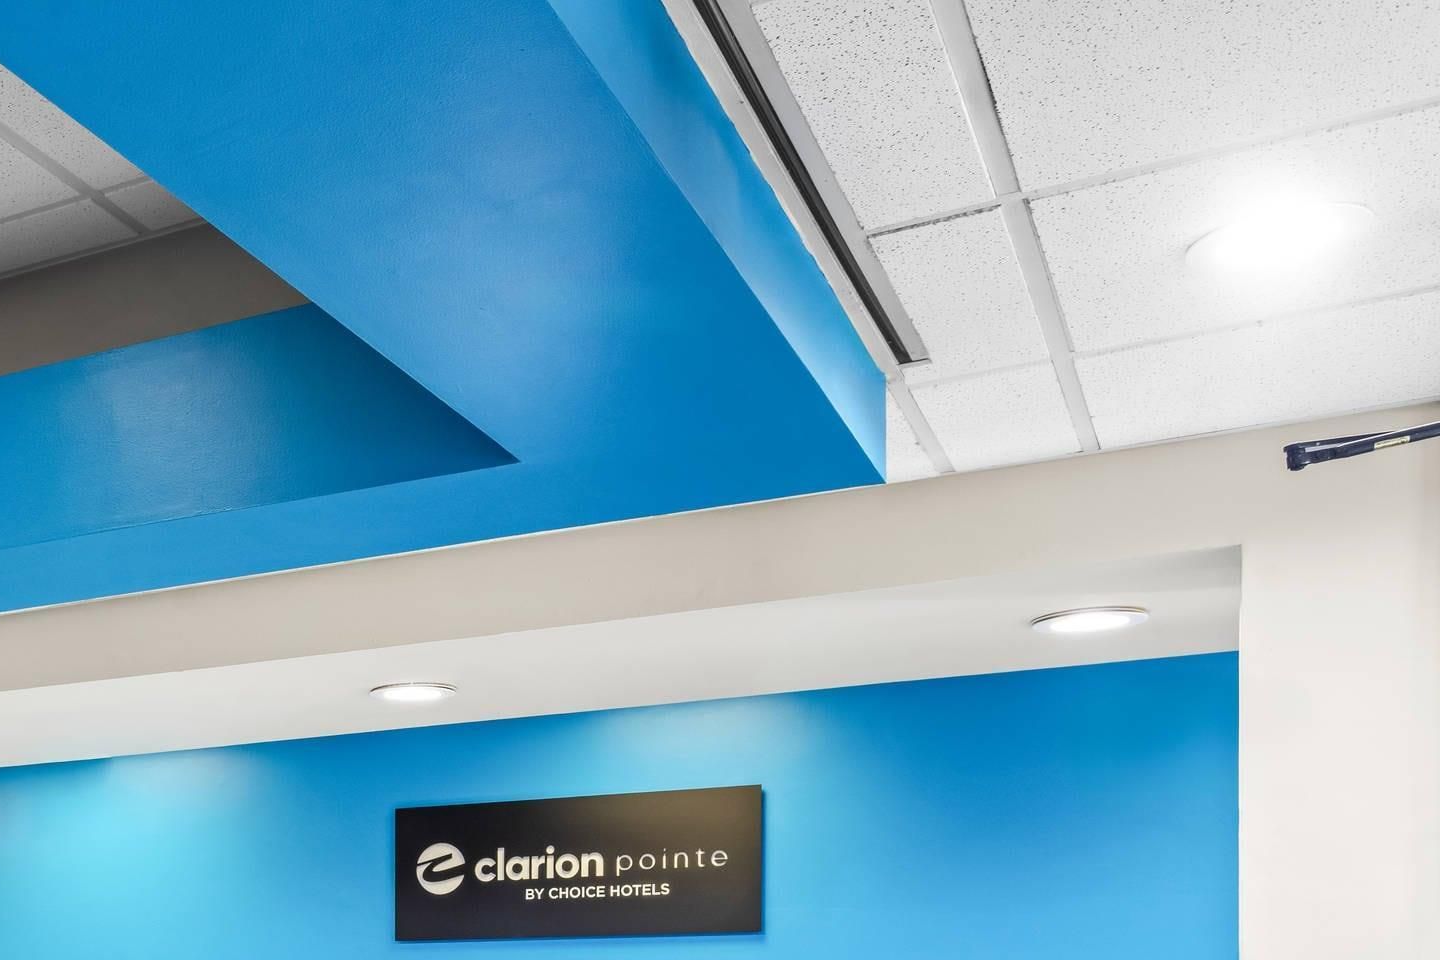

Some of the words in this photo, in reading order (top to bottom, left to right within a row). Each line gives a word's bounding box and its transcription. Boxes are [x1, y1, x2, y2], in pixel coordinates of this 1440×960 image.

[474, 845, 604, 882] clarion
[616, 848, 728, 877] pointe
[525, 887, 544, 900] BY
[548, 885, 605, 899] CHOICE
[610, 883, 670, 898] HOTELS
